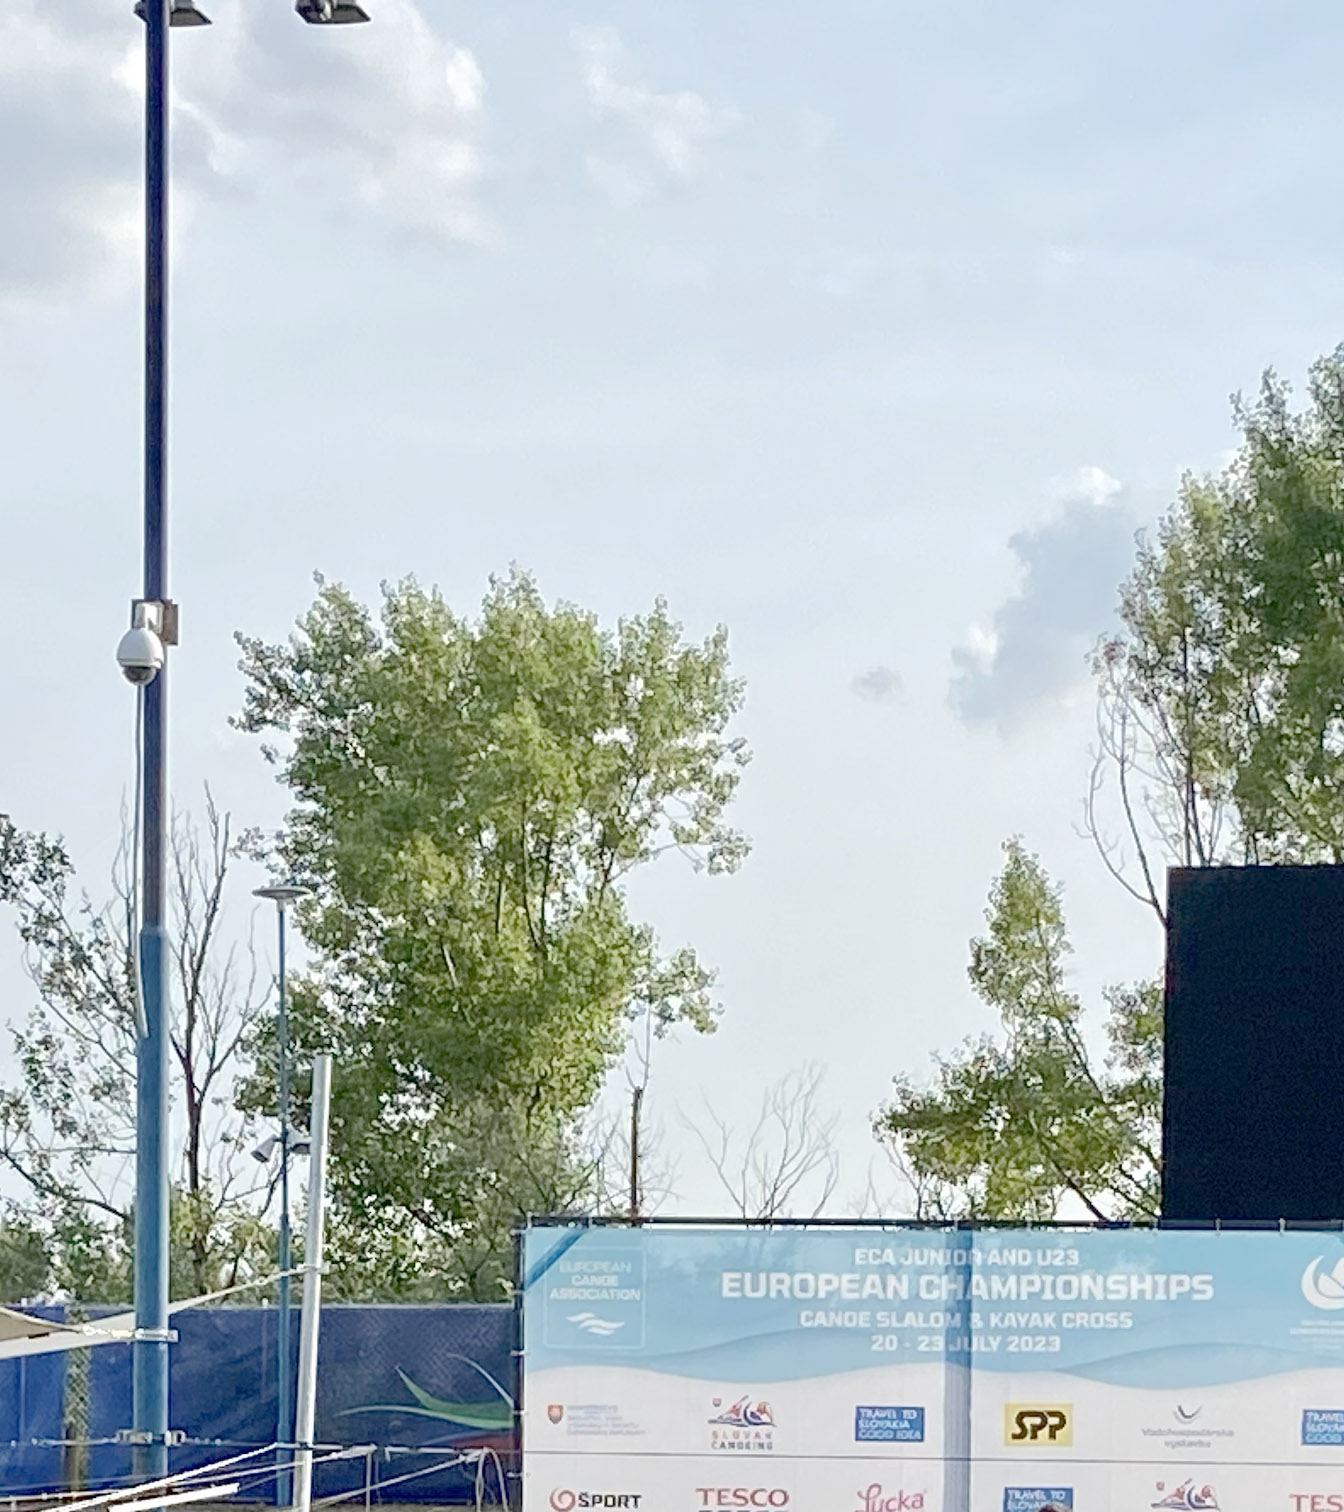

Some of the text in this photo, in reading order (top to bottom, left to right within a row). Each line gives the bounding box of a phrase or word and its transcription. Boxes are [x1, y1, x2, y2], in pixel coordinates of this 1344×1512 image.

[855, 1249, 1079, 1266] ECA JUNIOR AND U23
[721, 1272, 1214, 1301] EUROPEAN CHAMPIONSHIPS
[799, 1311, 1133, 1329] CANOE SLALOM & KAYAK CROSS
[871, 1335, 898, 1351] 20
[917, 1335, 944, 1351] 23
[949, 1335, 1002, 1352] JULY
[1007, 1335, 1061, 1352] 2023
[1011, 1410, 1067, 1441] SPP
[578, 1492, 642, 1509] ŠPORT
[696, 1488, 789, 1507] TESCO
